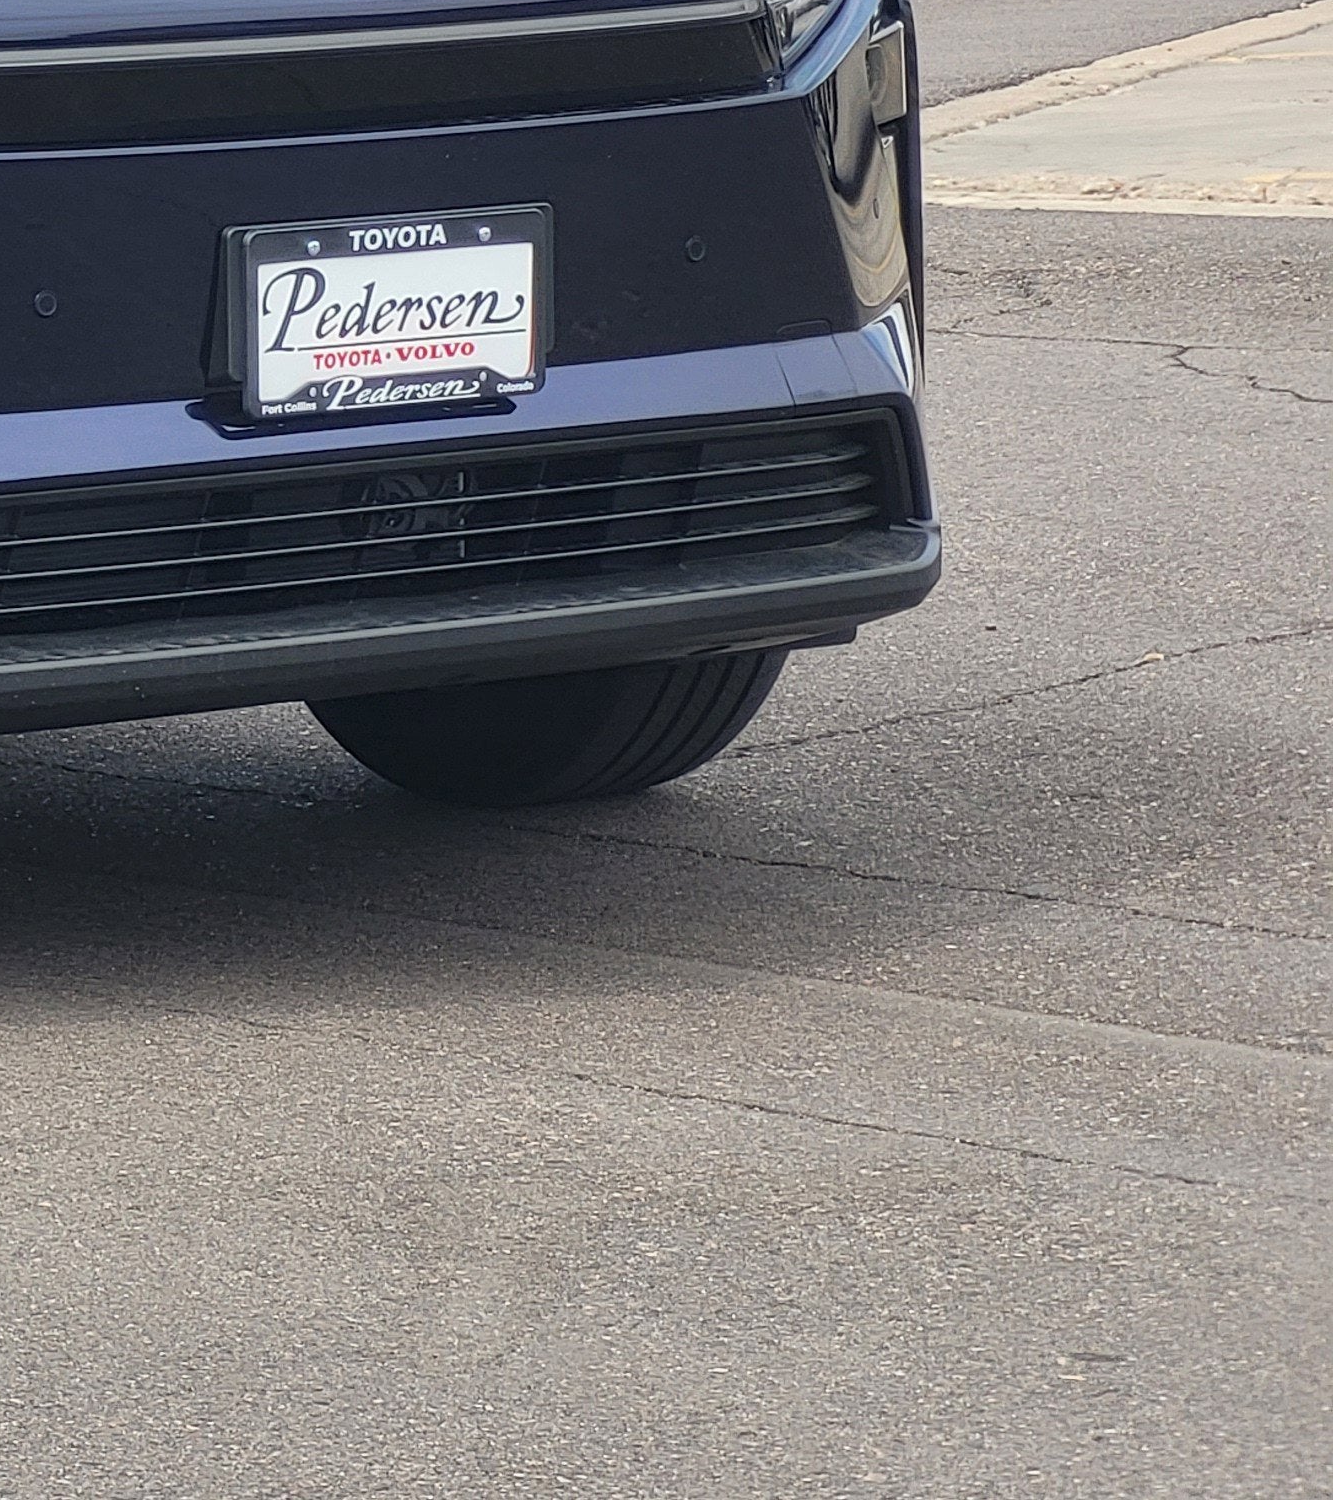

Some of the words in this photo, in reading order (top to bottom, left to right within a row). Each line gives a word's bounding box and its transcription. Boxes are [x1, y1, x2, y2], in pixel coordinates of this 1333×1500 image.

[349, 224, 447, 252] TOYOTA
[263, 267, 526, 353] Pedersen
[313, 349, 382, 370] TOYOTA
[394, 341, 475, 362] VOLVO
[323, 374, 481, 411] Pedersen
